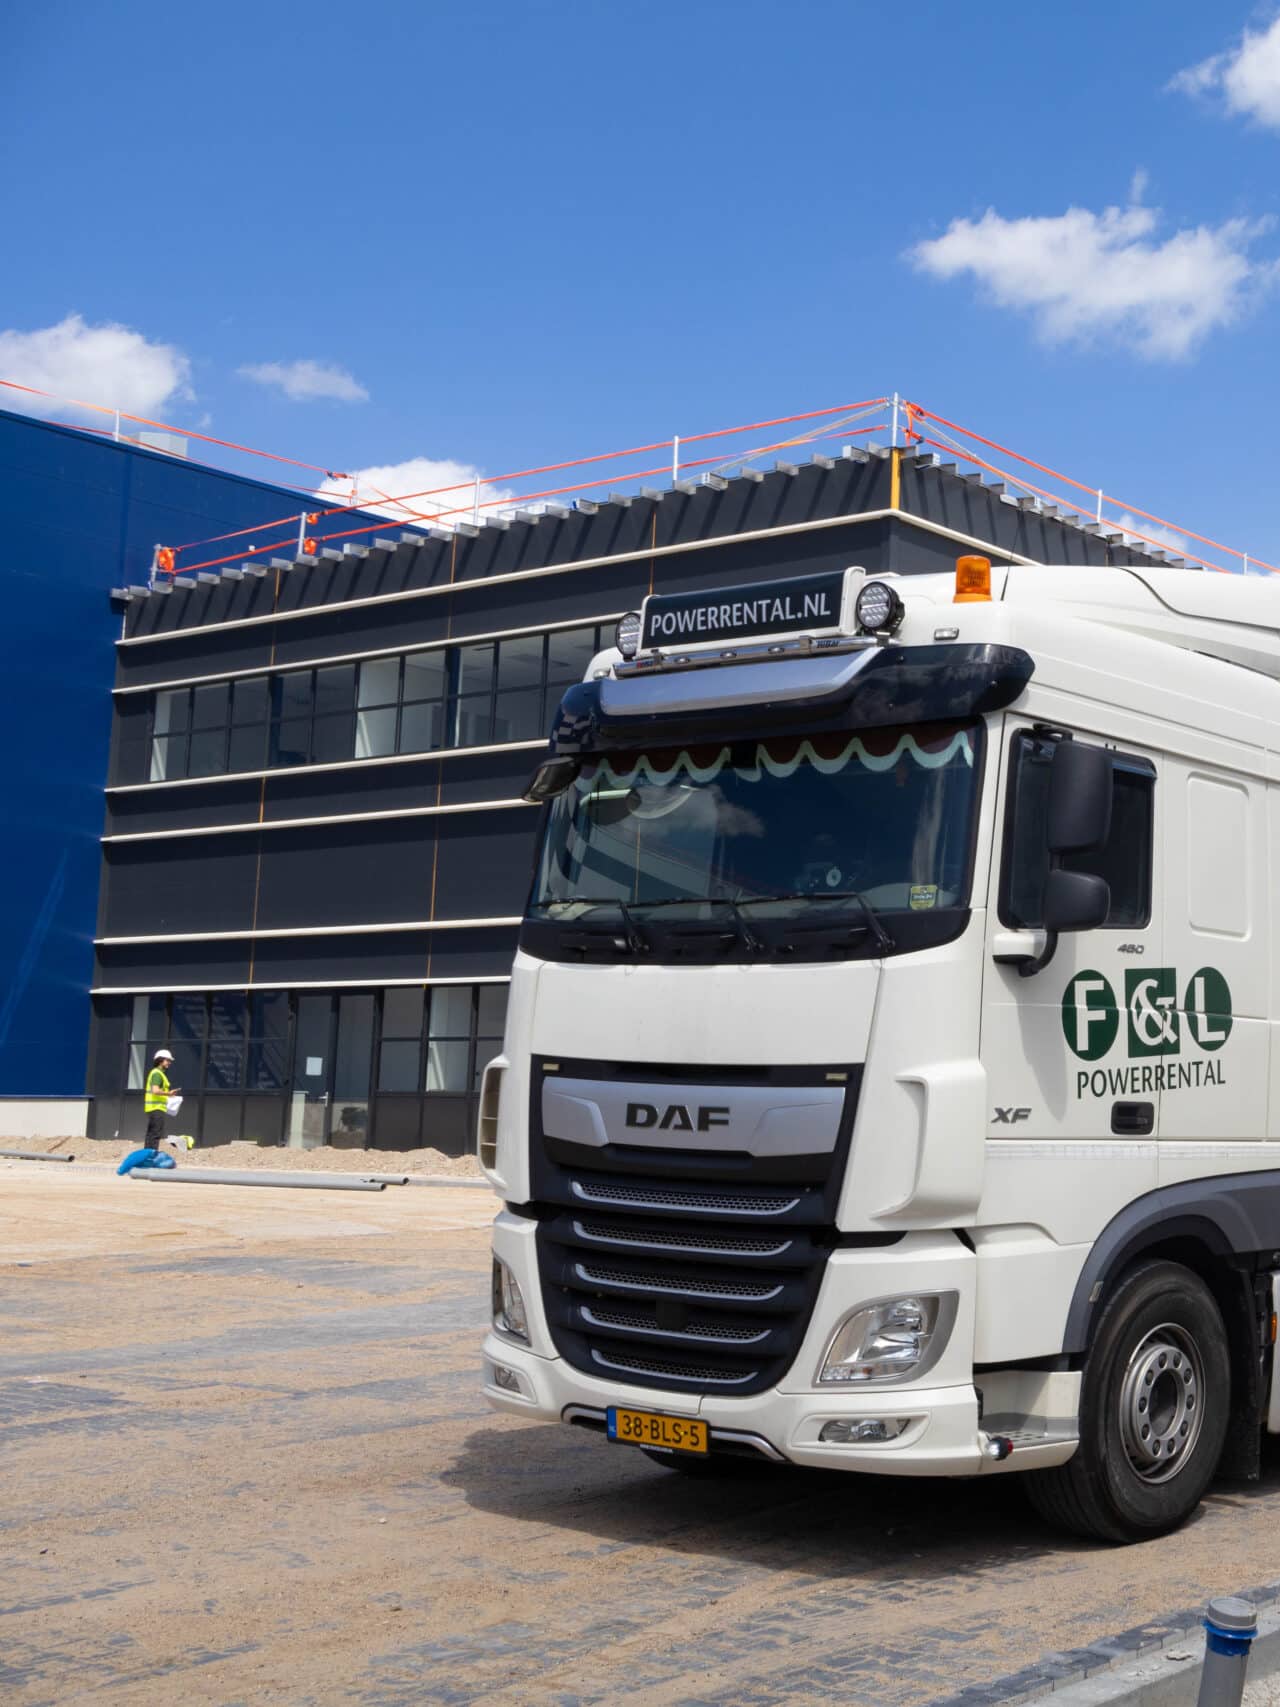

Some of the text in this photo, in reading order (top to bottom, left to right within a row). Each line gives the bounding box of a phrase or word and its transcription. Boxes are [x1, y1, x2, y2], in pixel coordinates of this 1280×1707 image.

[651, 593, 831, 637] POWERRENTAL.NL
[1074, 976, 1227, 1052] F&L
[1077, 1059, 1227, 1100] POWERRENTAL
[625, 1102, 731, 1132] DAF
[991, 1107, 1033, 1124] XF
[622, 1414, 700, 1447] 38-BLS-5
